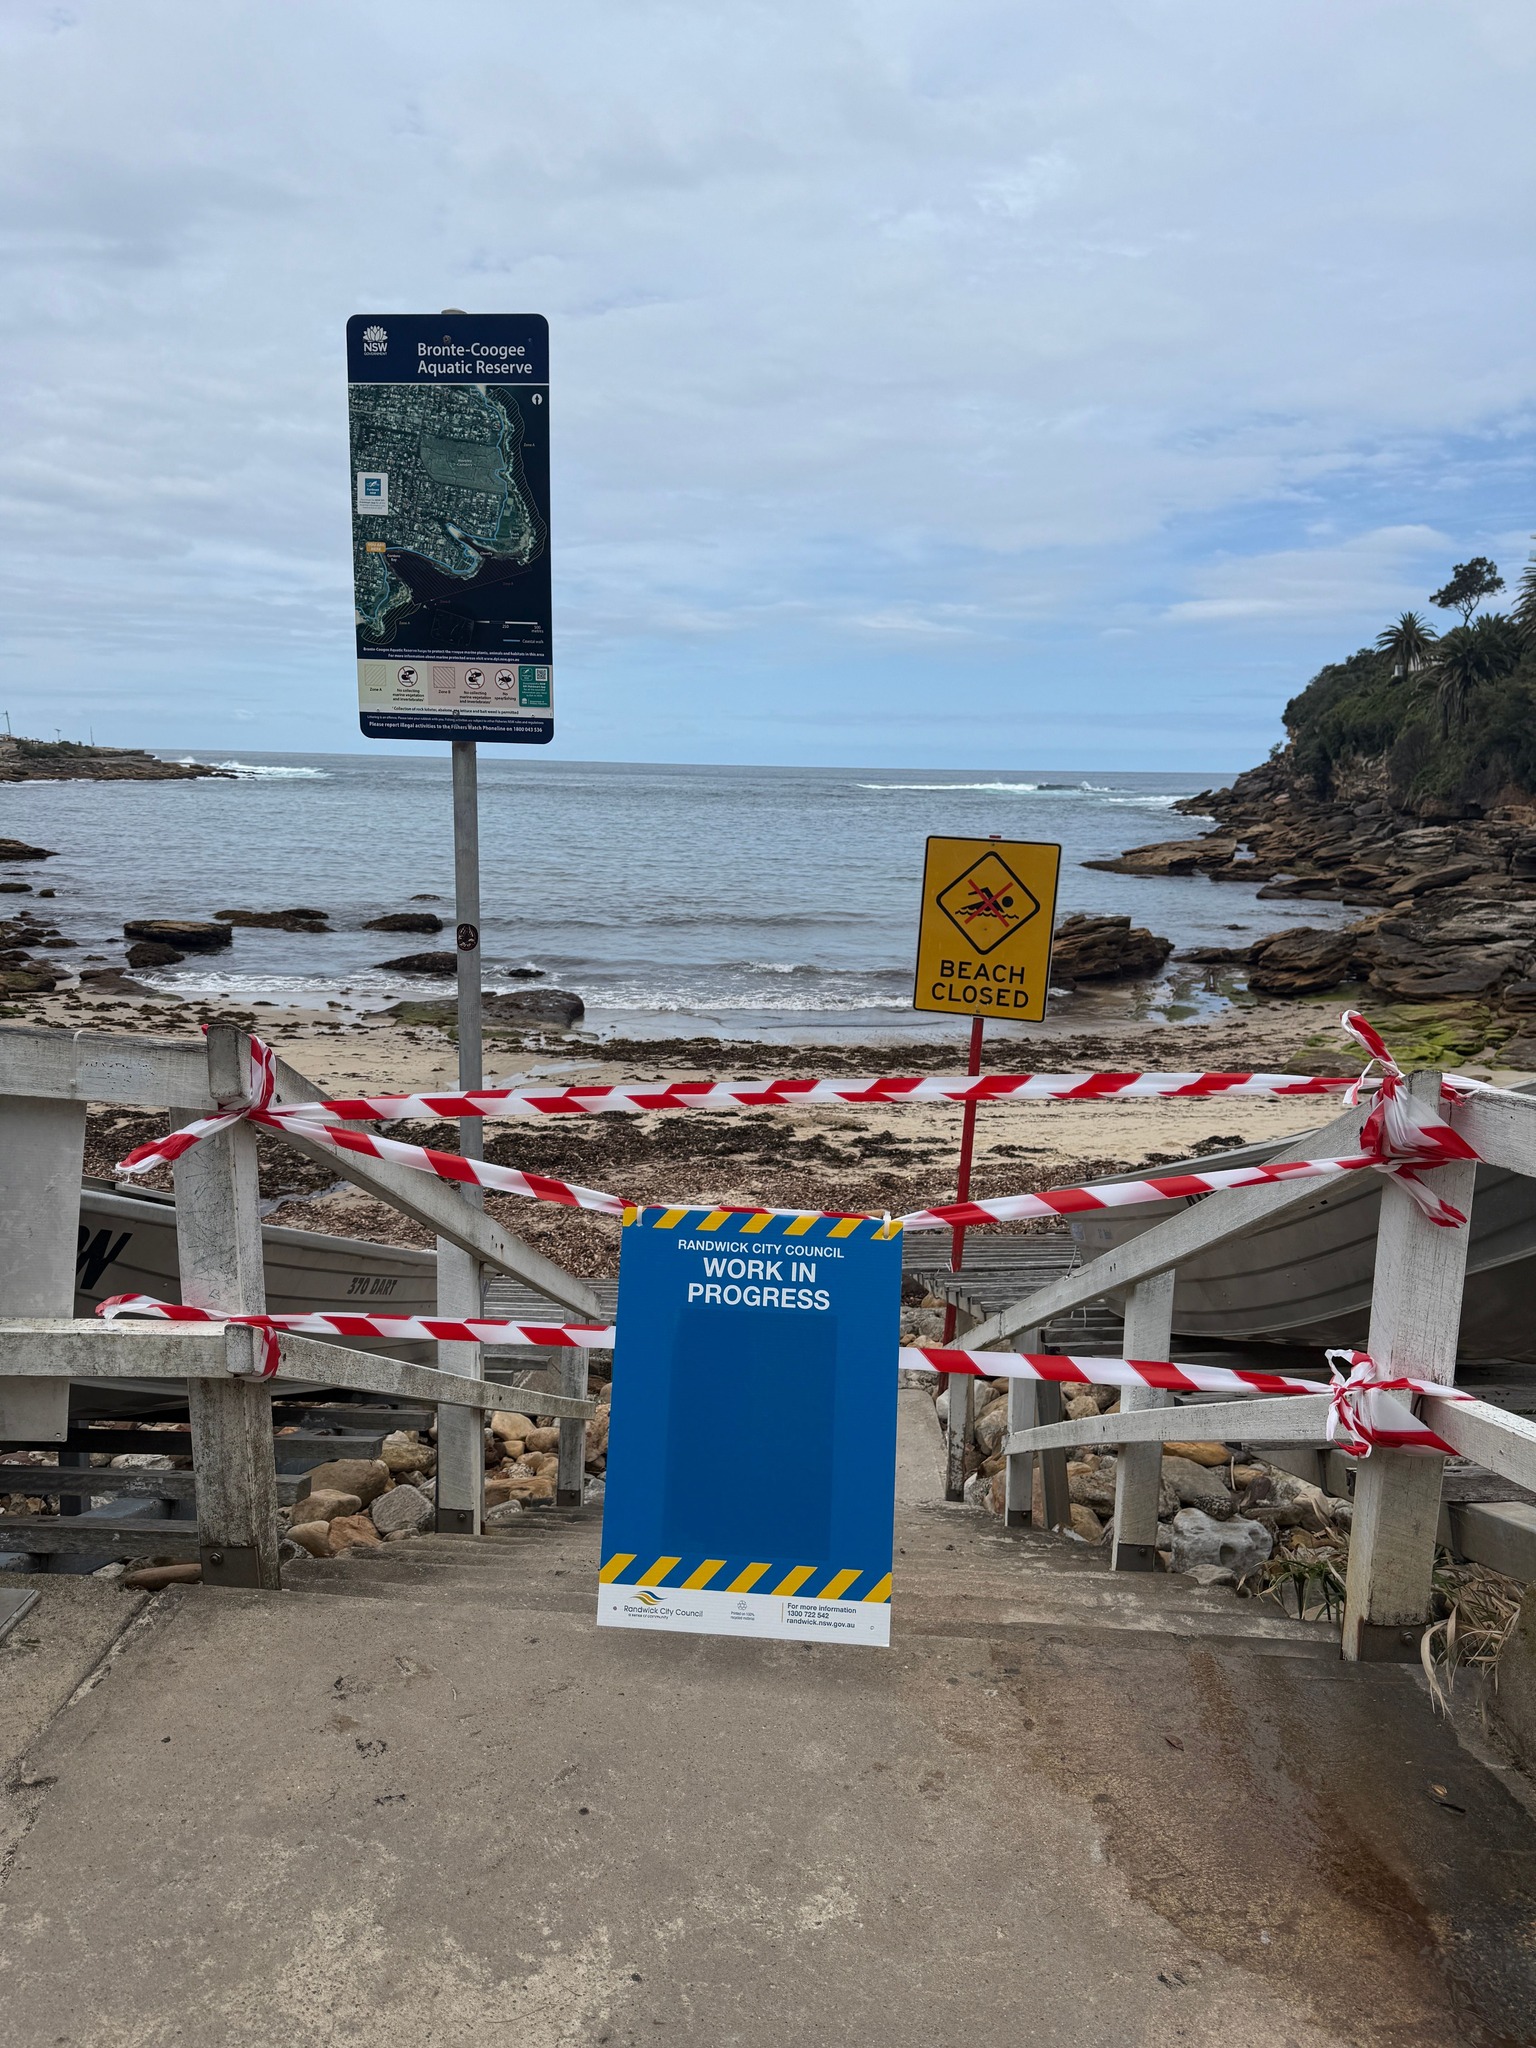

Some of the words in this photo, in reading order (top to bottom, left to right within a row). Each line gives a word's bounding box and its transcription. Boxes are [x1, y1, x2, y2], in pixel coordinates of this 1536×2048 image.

[364, 342, 388, 352] NSW
[417, 343, 526, 359] Bronte-Coogee
[417, 361, 472, 376] Aquatic
[476, 361, 532, 374] Reserve
[940, 960, 1024, 984] BEACH
[932, 982, 1029, 1008] CLOSED
[678, 1239, 748, 1253] RANDWICK
[752, 1243, 781, 1255] CITY
[785, 1245, 844, 1258] COUNCIL
[703, 1258, 782, 1281] WORK
[791, 1262, 816, 1282] IN
[347, 1277, 370, 1294] 370
[369, 1278, 398, 1295] DART
[688, 1283, 830, 1310] PROGRESS
[624, 1605, 658, 1614] Randwick
[660, 1608, 674, 1616] City
[676, 1609, 703, 1617] Council
[819, 1605, 856, 1613] information
[786, 1618, 855, 1628] randwick.nsw.gov.au
